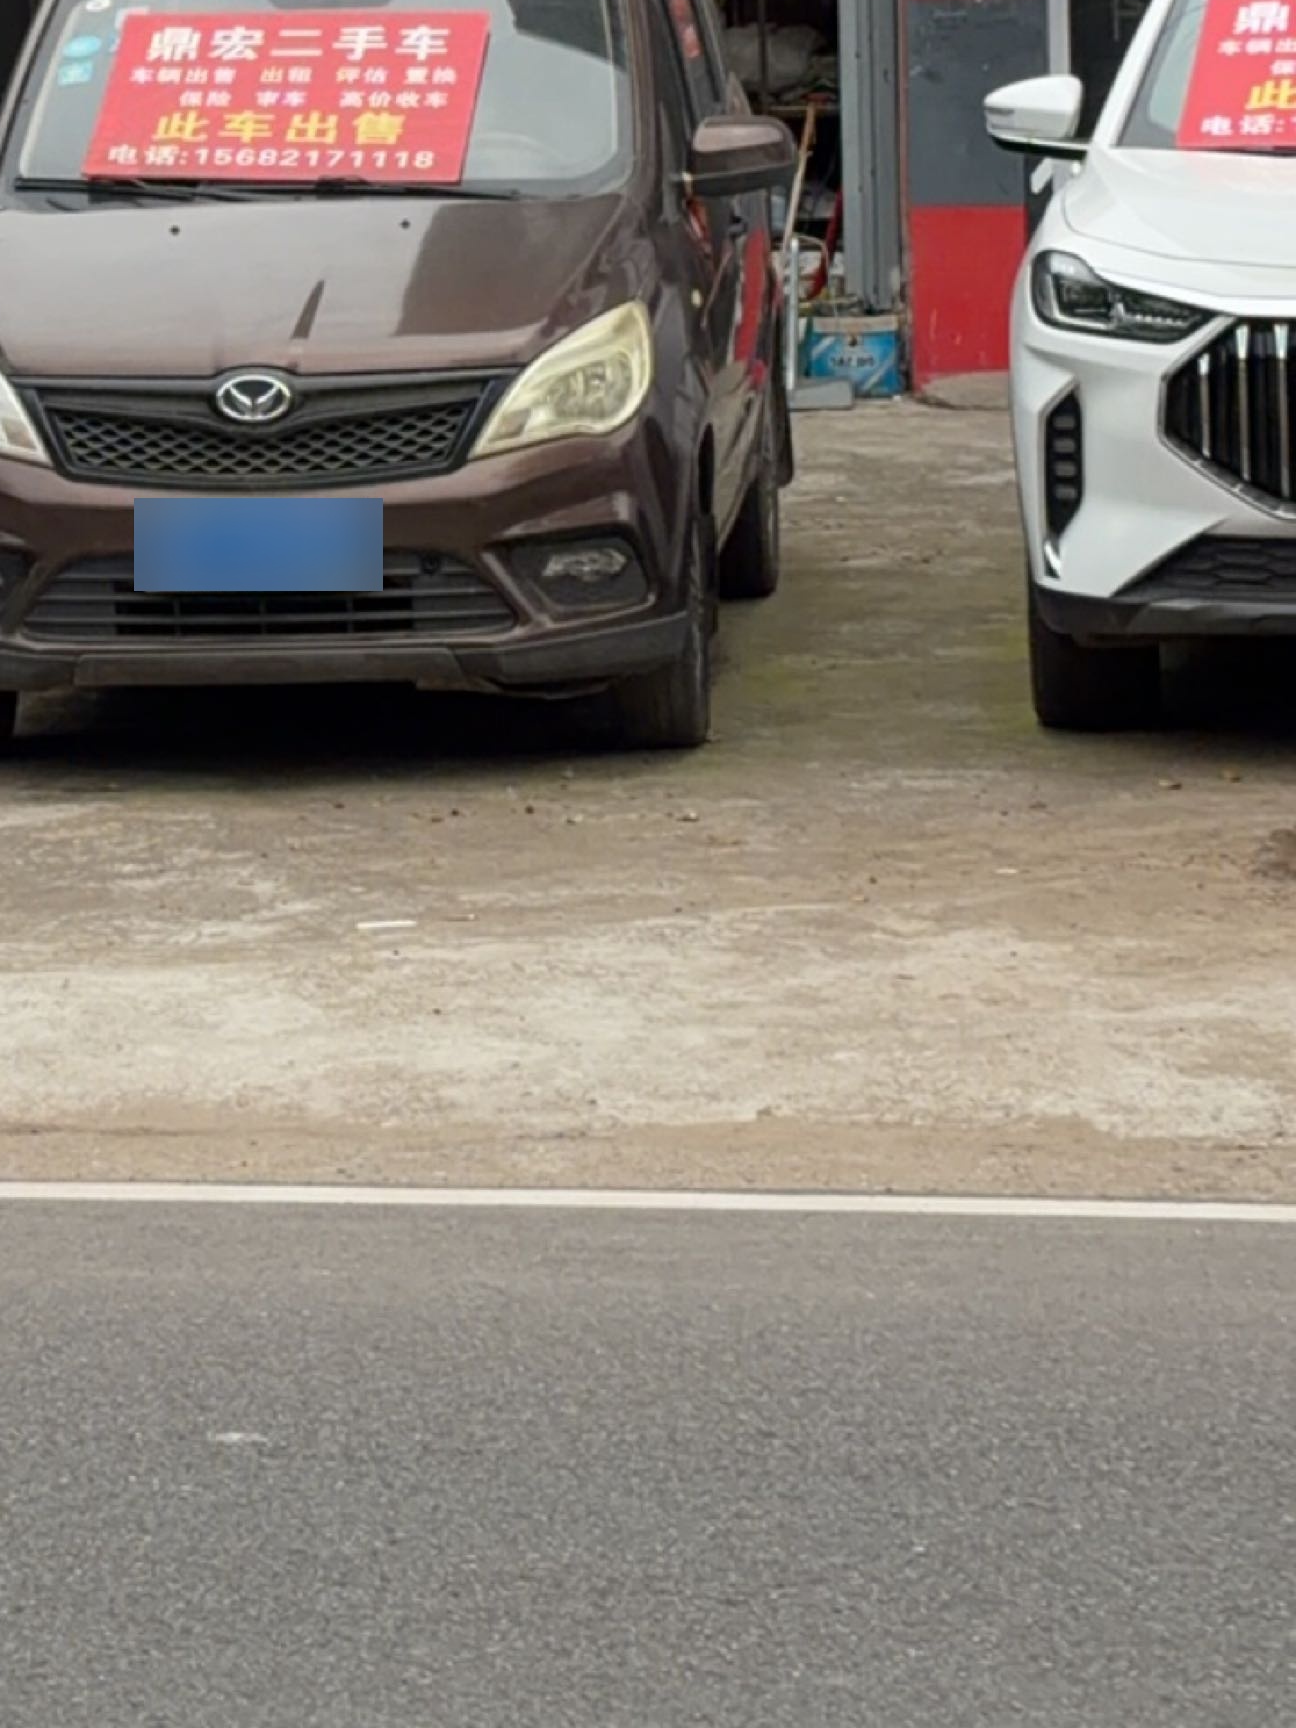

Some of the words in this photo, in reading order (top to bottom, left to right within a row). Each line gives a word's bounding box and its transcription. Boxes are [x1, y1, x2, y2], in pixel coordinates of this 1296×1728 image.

[147, 25, 449, 62] 鼎宏二手车
[152, 111, 406, 145] 此车出售
